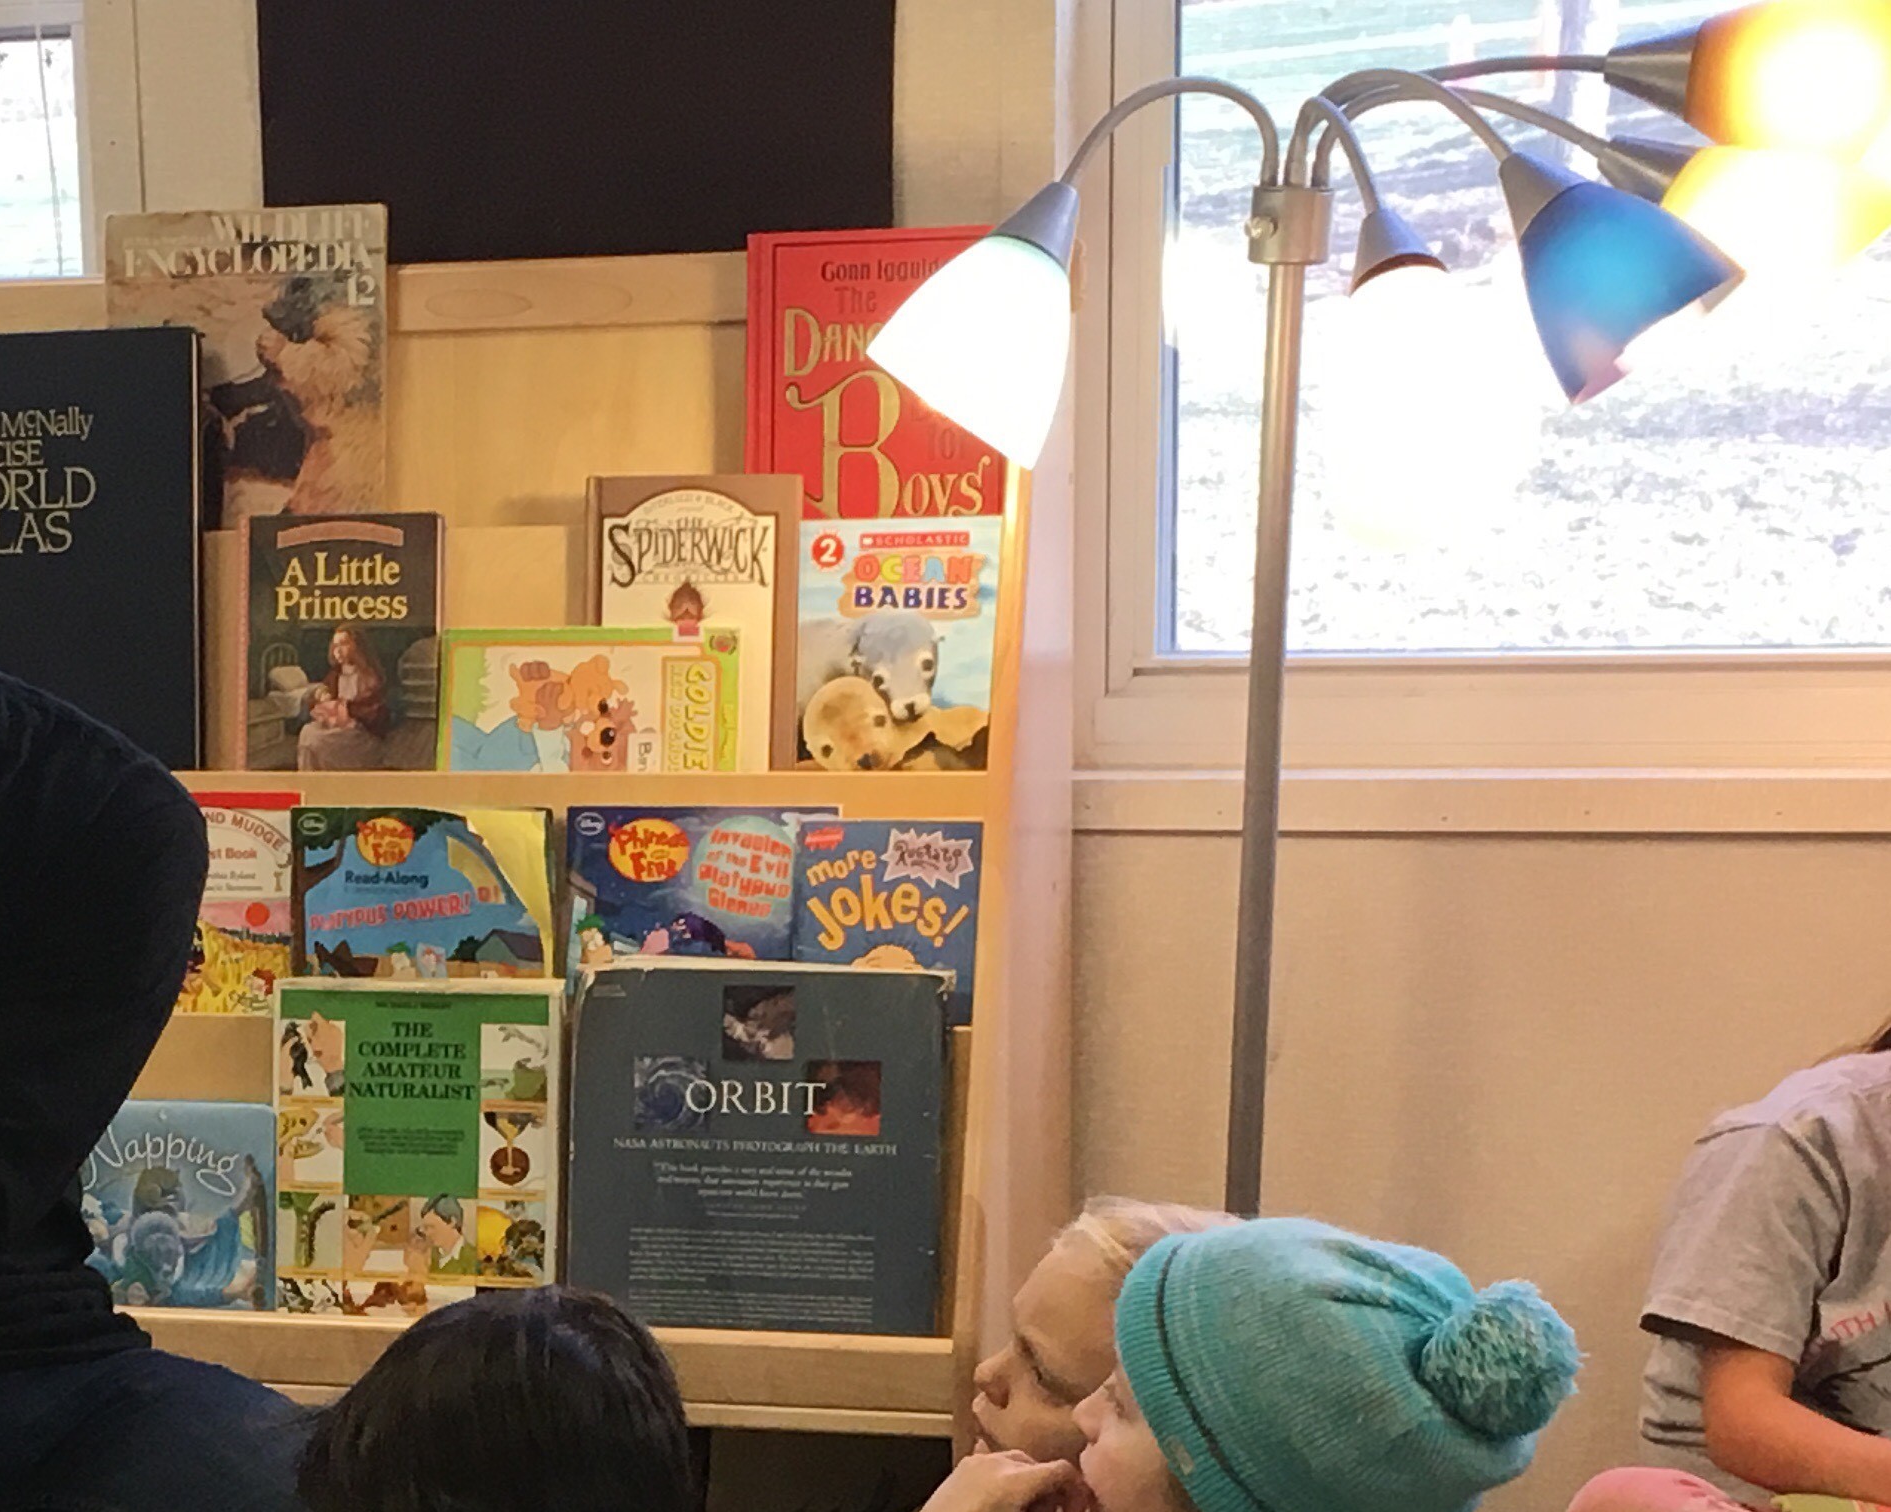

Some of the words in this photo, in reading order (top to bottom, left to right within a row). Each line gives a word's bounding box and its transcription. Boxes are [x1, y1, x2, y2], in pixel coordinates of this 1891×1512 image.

[124, 241, 374, 279] ENCYCLOPEDIA
[347, 274, 376, 306] 12
[833, 286, 878, 315] The
[608, 520, 771, 588] SPIDERWICK
[819, 538, 838, 563] 2
[875, 532, 968, 547] SCHOLASTIC
[281, 556, 308, 586] A
[313, 551, 402, 586] Little
[853, 553, 974, 585] OCEAN
[274, 586, 408, 621] Princess
[854, 584, 969, 610] BABIES
[204, 811, 226, 824] ND
[231, 813, 286, 852] MUDGE
[344, 869, 430, 889] Read-Along
[806, 849, 878, 888] more
[806, 873, 970, 951] Jokes!
[391, 1021, 434, 1038] THE
[357, 1040, 467, 1060] COMPLETE
[362, 1061, 462, 1080] AMATEUR
[348, 1082, 476, 1101] NATURALIST
[684, 1079, 828, 1116] ORBIT
[83, 1124, 240, 1196] Napping
[612, 1137, 647, 1149] NASA
[649, 1138, 731, 1152] ASTRONAUTS
[732, 1140, 820, 1154] PHOTOGRAPH
[823, 1142, 850, 1155] THE
[853, 1143, 898, 1156] EARTH
